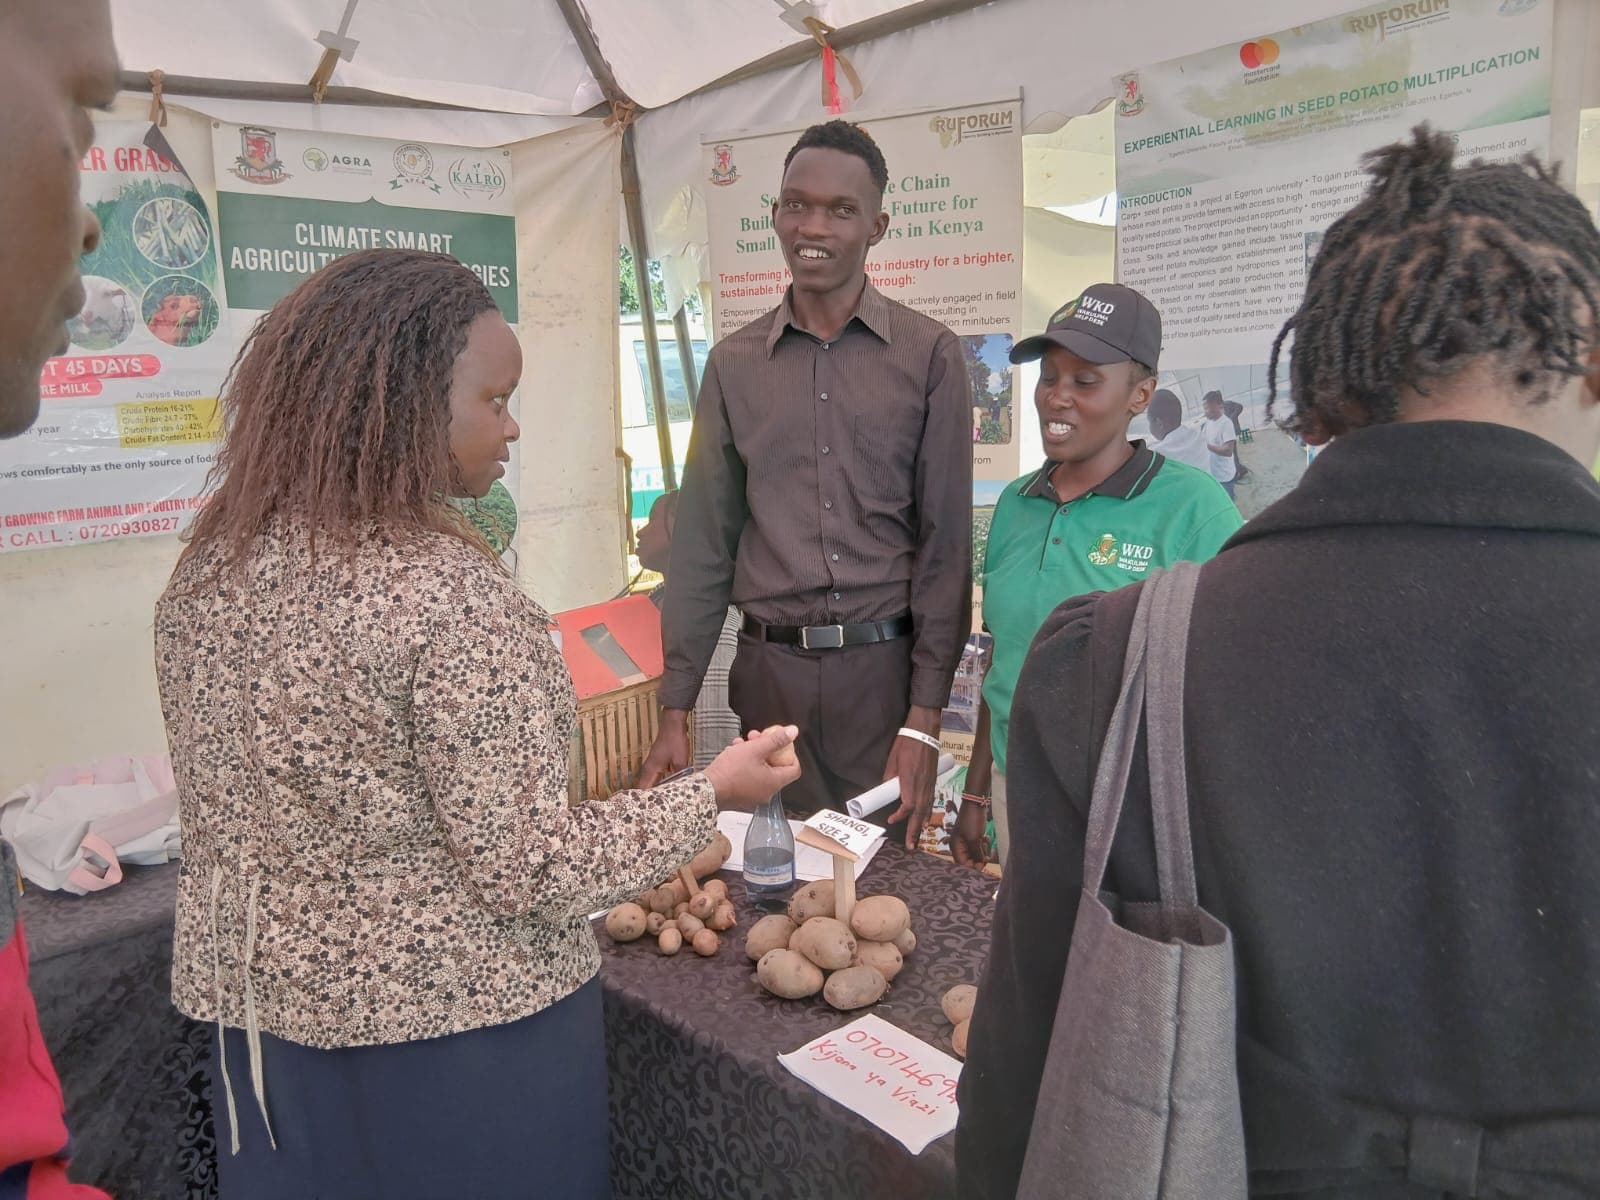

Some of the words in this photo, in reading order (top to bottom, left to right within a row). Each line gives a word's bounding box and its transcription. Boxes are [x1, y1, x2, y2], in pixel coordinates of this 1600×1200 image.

[1244, 72, 1280, 85] foundation
[1124, 125, 1205, 154] EXPERIENTIAL
[1208, 108, 1276, 133] LEARNING
[1280, 103, 1293, 118] IN
[1297, 95, 1335, 114] SEED
[1339, 80, 1399, 105] POTATO
[1403, 46, 1541, 91] MULTIPLICATION
[935, 110, 1013, 144] RUFORUM
[1508, 138, 1527, 149] and
[332, 154, 372, 168] AGRA
[452, 170, 502, 187] KALRO
[900, 173, 951, 192] Chain
[1311, 174, 1323, 184] To
[1324, 172, 1342, 184] gain
[1309, 181, 1363, 197] management
[891, 199, 946, 217] Future
[952, 194, 978, 210] for
[1143, 207, 1160, 217] seed
[1162, 203, 1183, 214] potato
[1200, 195, 1222, 208] project
[1234, 188, 1262, 200] Egerton
[1265, 181, 1303, 193] university
[1311, 196, 1341, 209] engage
[1343, 194, 1359, 204] and
[1122, 222, 1144, 232] whose
[1182, 210, 1206, 222] provide
[1206, 206, 1232, 217] farmers
[1234, 202, 1248, 211] with
[1249, 199, 1275, 209] access
[1276, 196, 1284, 204] to
[1286, 193, 1303, 204] high
[1145, 230, 1161, 239] seed
[1184, 223, 1197, 232] The
[1197, 219, 1219, 231] project
[1220, 214, 1249, 227] provided
[1251, 212, 1260, 220] an
[1260, 206, 1303, 220] opportunity
[295, 222, 382, 249] CLIMATE
[385, 229, 453, 255] SMART
[736, 236, 776, 254] Small
[907, 222, 923, 238] in
[929, 219, 984, 237] Kenya
[1155, 239, 1181, 250] practical
[1200, 232, 1217, 241] other
[1218, 229, 1233, 239] than
[1234, 227, 1245, 236] the
[1246, 223, 1269, 235] theory
[1270, 218, 1295, 231] taught
[1296, 218, 1303, 226] in
[1146, 253, 1163, 262] Skills
[1167, 250, 1179, 258] and
[1182, 245, 1218, 256] knowledge
[1222, 240, 1246, 251] gained
[1249, 235, 1275, 246] include
[1280, 231, 1303, 241] tissue
[719, 270, 782, 285] Transforming
[885, 257, 930, 271] industry
[934, 255, 950, 268] for
[953, 256, 960, 265] a
[963, 252, 1015, 267] brighter,
[1123, 267, 1146, 277] culture
[1149, 263, 1164, 273] seed
[1166, 261, 1187, 271] potato
[1236, 245, 1287, 259] establishment
[1289, 243, 1304, 252] and
[1123, 275, 1167, 287] management
[1180, 269, 1216, 279] aeroponics
[1219, 265, 1233, 274] and
[1236, 259, 1280, 272] hydroponics
[1285, 255, 1304, 265] seed
[720, 284, 774, 298] sustainable
[1151, 283, 1194, 295] conventional
[1198, 279, 1215, 288] seed
[1218, 276, 1241, 286] potato
[1244, 271, 1284, 283] production
[1289, 268, 1303, 276] and
[907, 296, 940, 306] actively
[942, 292, 982, 304] engaged
[985, 291, 993, 300] in
[996, 290, 1016, 300] field
[1160, 296, 1181, 305] Based
[1194, 293, 1205, 302] my
[1207, 286, 1247, 298] observation
[1250, 283, 1271, 293] within
[1274, 282, 1286, 290] the
[1289, 280, 1304, 288] one
[929, 305, 967, 316] resulting
[969, 304, 977, 313] in
[1082, 296, 1115, 315] WKD
[1187, 303, 1209, 314] potato
[1212, 299, 1241, 310] farmers
[1244, 297, 1262, 306] have
[1267, 295, 1282, 304] very
[962, 315, 1010, 326] minitubers
[66, 359, 86, 375] 45
[91, 358, 142, 374] DAYS
[60, 382, 91, 394] MILK
[136, 390, 171, 400] Analysis
[174, 389, 201, 399] Report
[144, 405, 169, 414] Protein
[37, 425, 61, 436] year
[125, 436, 146, 445] Crude
[161, 433, 187, 442] Content
[21, 464, 87, 477] comfortably
[104, 462, 122, 471] the
[124, 459, 146, 471] only
[149, 457, 182, 467] source
[184, 456, 194, 465] of
[5, 513, 55, 528] GROWING
[57, 508, 85, 523] FARM
[86, 504, 124, 519] ANIMAL
[125, 502, 145, 515] AND
[10, 530, 63, 547] CALL
[79, 516, 180, 540] 0720930827
[1122, 543, 1153, 560] WKD
[817, 822, 843, 839] SIZE
[823, 811, 871, 837] SHANGI,
[809, 1039, 857, 1071] Kijana
[865, 1071, 887, 1086] ya
[891, 1086, 941, 1116] Viazi
